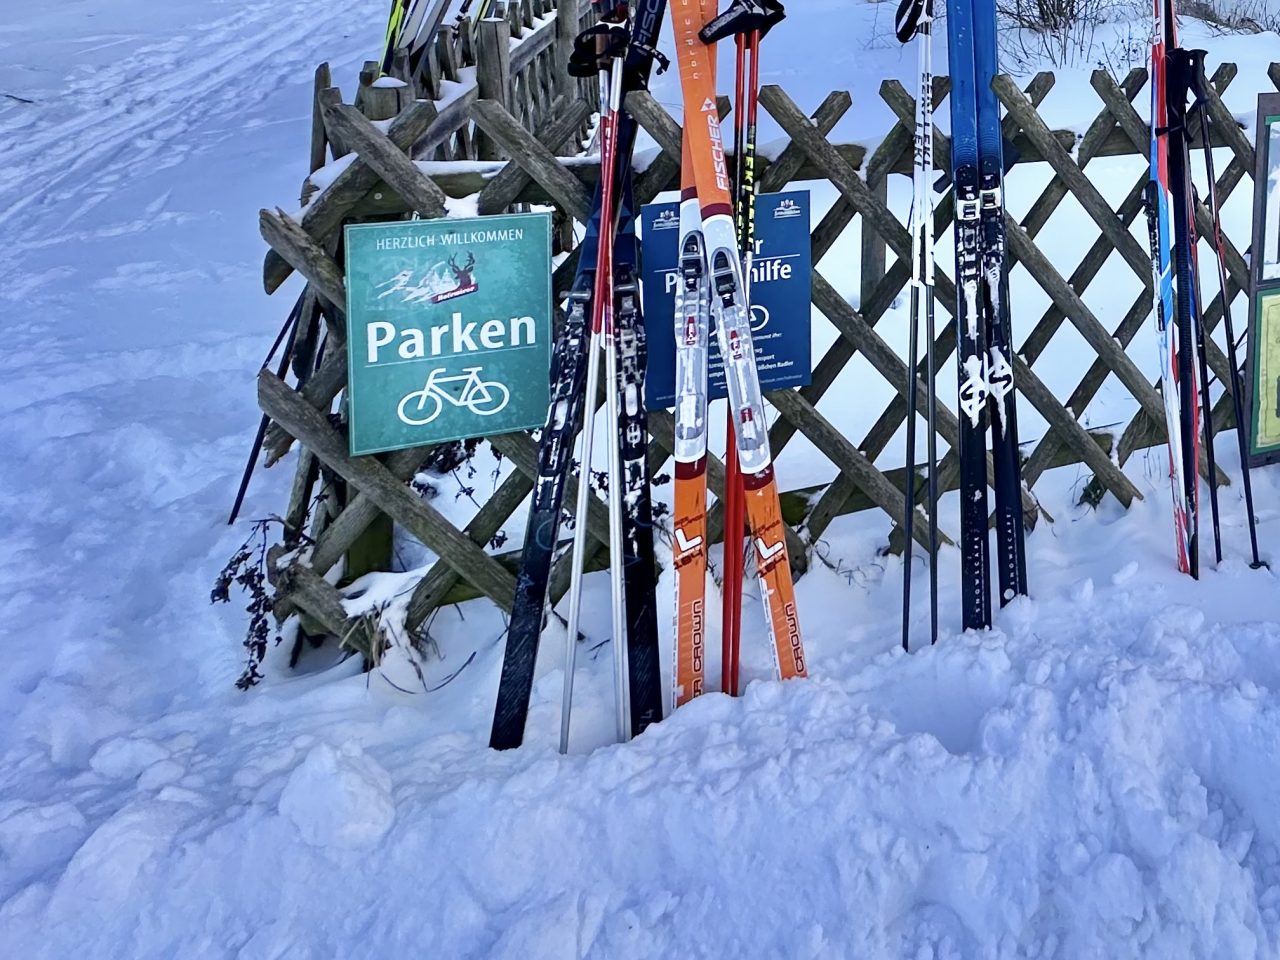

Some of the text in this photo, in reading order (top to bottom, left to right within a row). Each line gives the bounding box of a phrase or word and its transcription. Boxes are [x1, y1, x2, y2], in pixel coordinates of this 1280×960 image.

[707, 114, 729, 191] FISCHER
[376, 228, 524, 250] HERZLICH WILLKOMMEN
[366, 312, 536, 363] Parken
[691, 599, 702, 673] CROWN
[784, 603, 805, 674] CROWN
